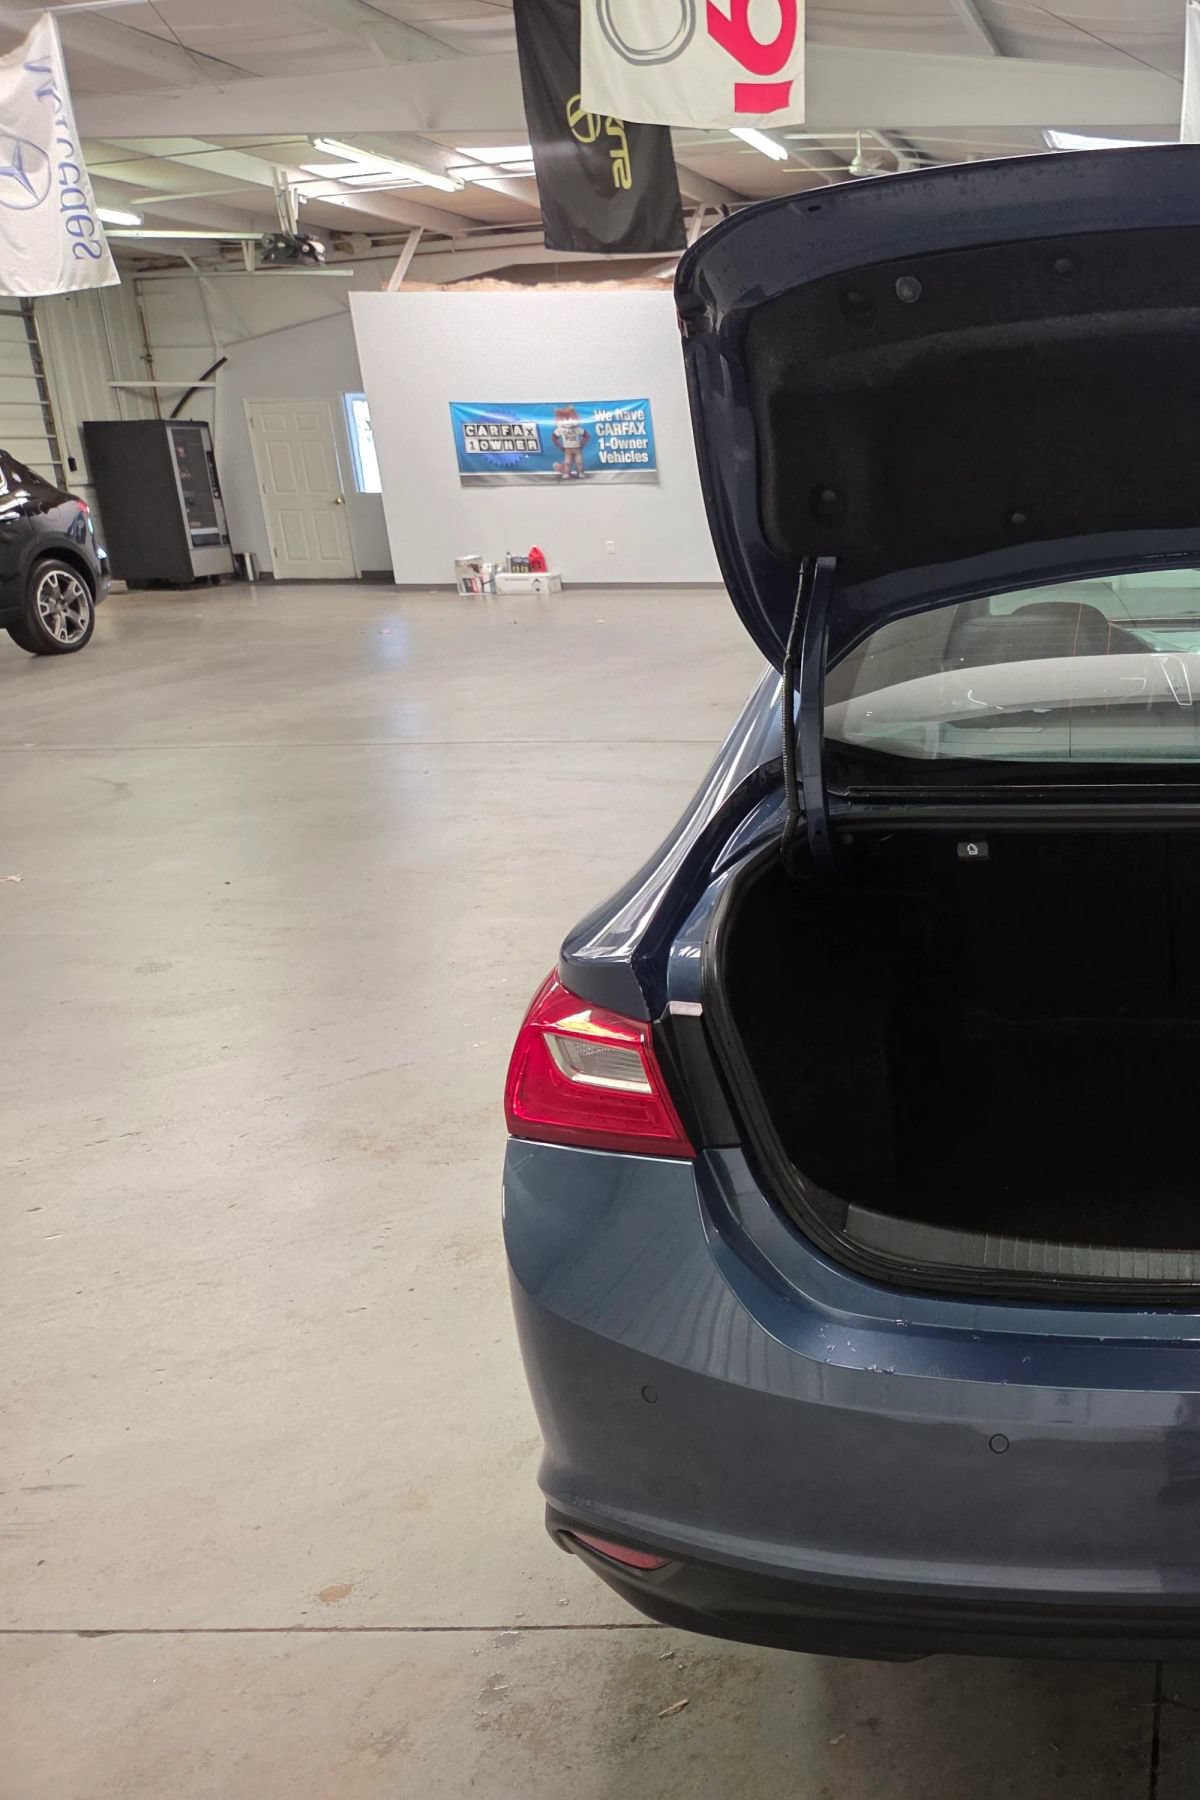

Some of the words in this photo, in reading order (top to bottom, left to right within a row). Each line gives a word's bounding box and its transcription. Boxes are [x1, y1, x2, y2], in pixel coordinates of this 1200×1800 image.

[465, 424, 534, 437] CARFAX
[595, 421, 647, 436] CARFAX
[598, 437, 648, 450] 1-Owner
[599, 450, 649, 463] Vehicles
